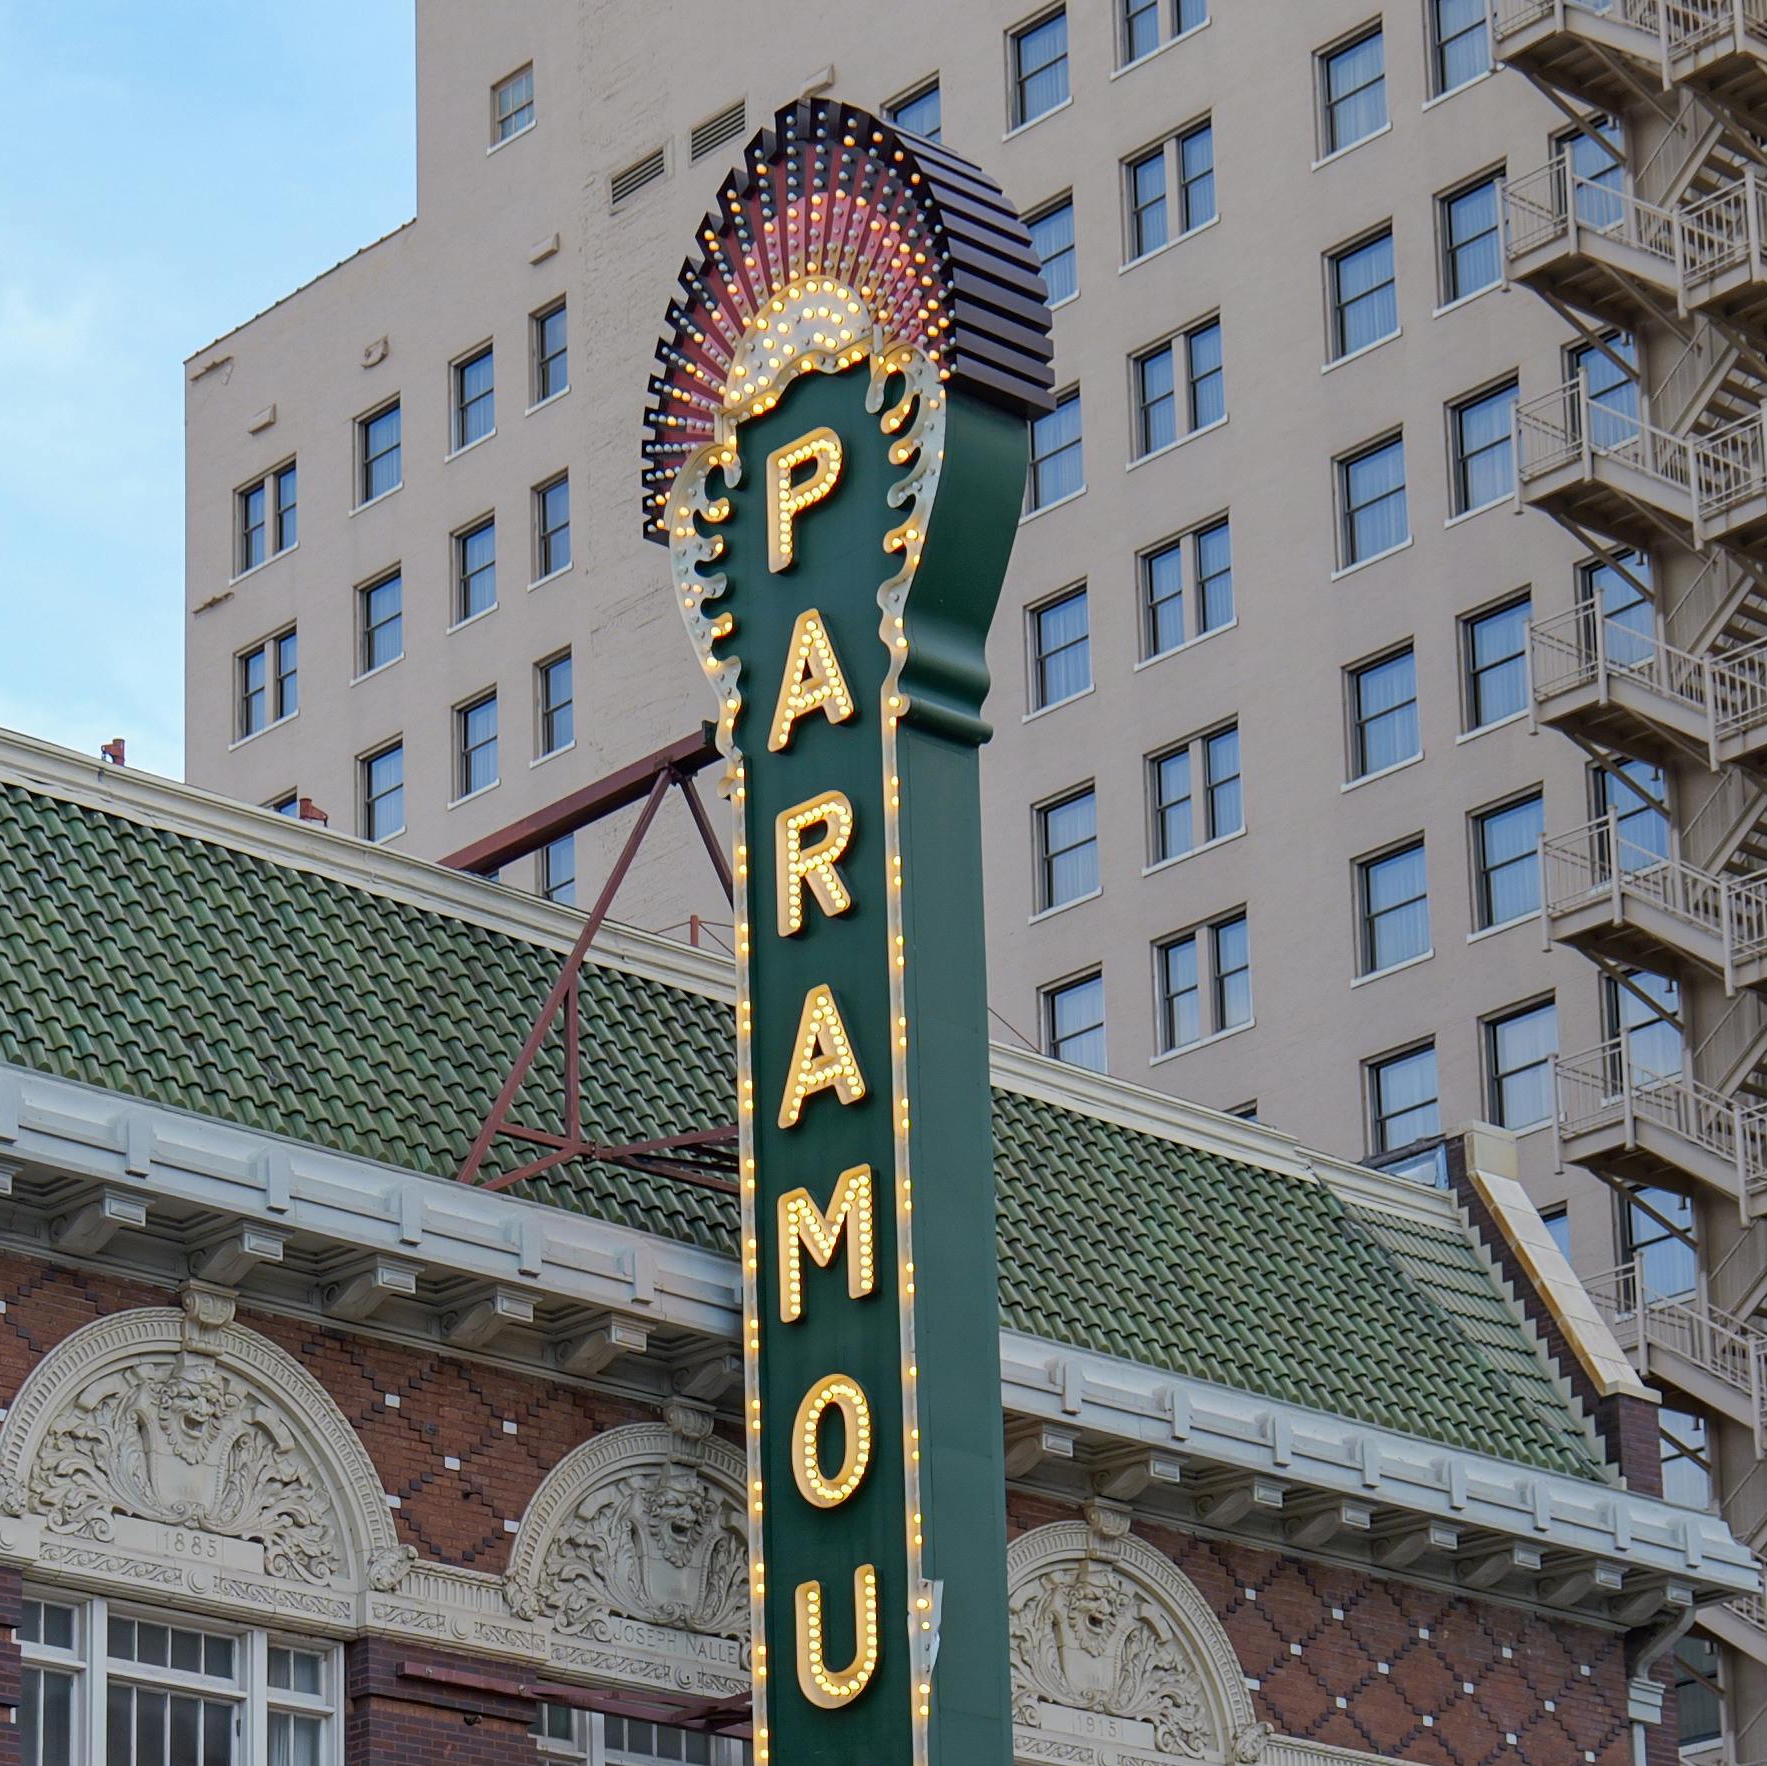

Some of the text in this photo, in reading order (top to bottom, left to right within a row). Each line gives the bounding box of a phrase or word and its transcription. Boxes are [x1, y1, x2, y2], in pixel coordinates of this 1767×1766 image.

[163, 1531, 217, 1558] 1885
[614, 1619, 737, 1665] JOSEPH NALLE
[1078, 1714, 1117, 1738] 1915
